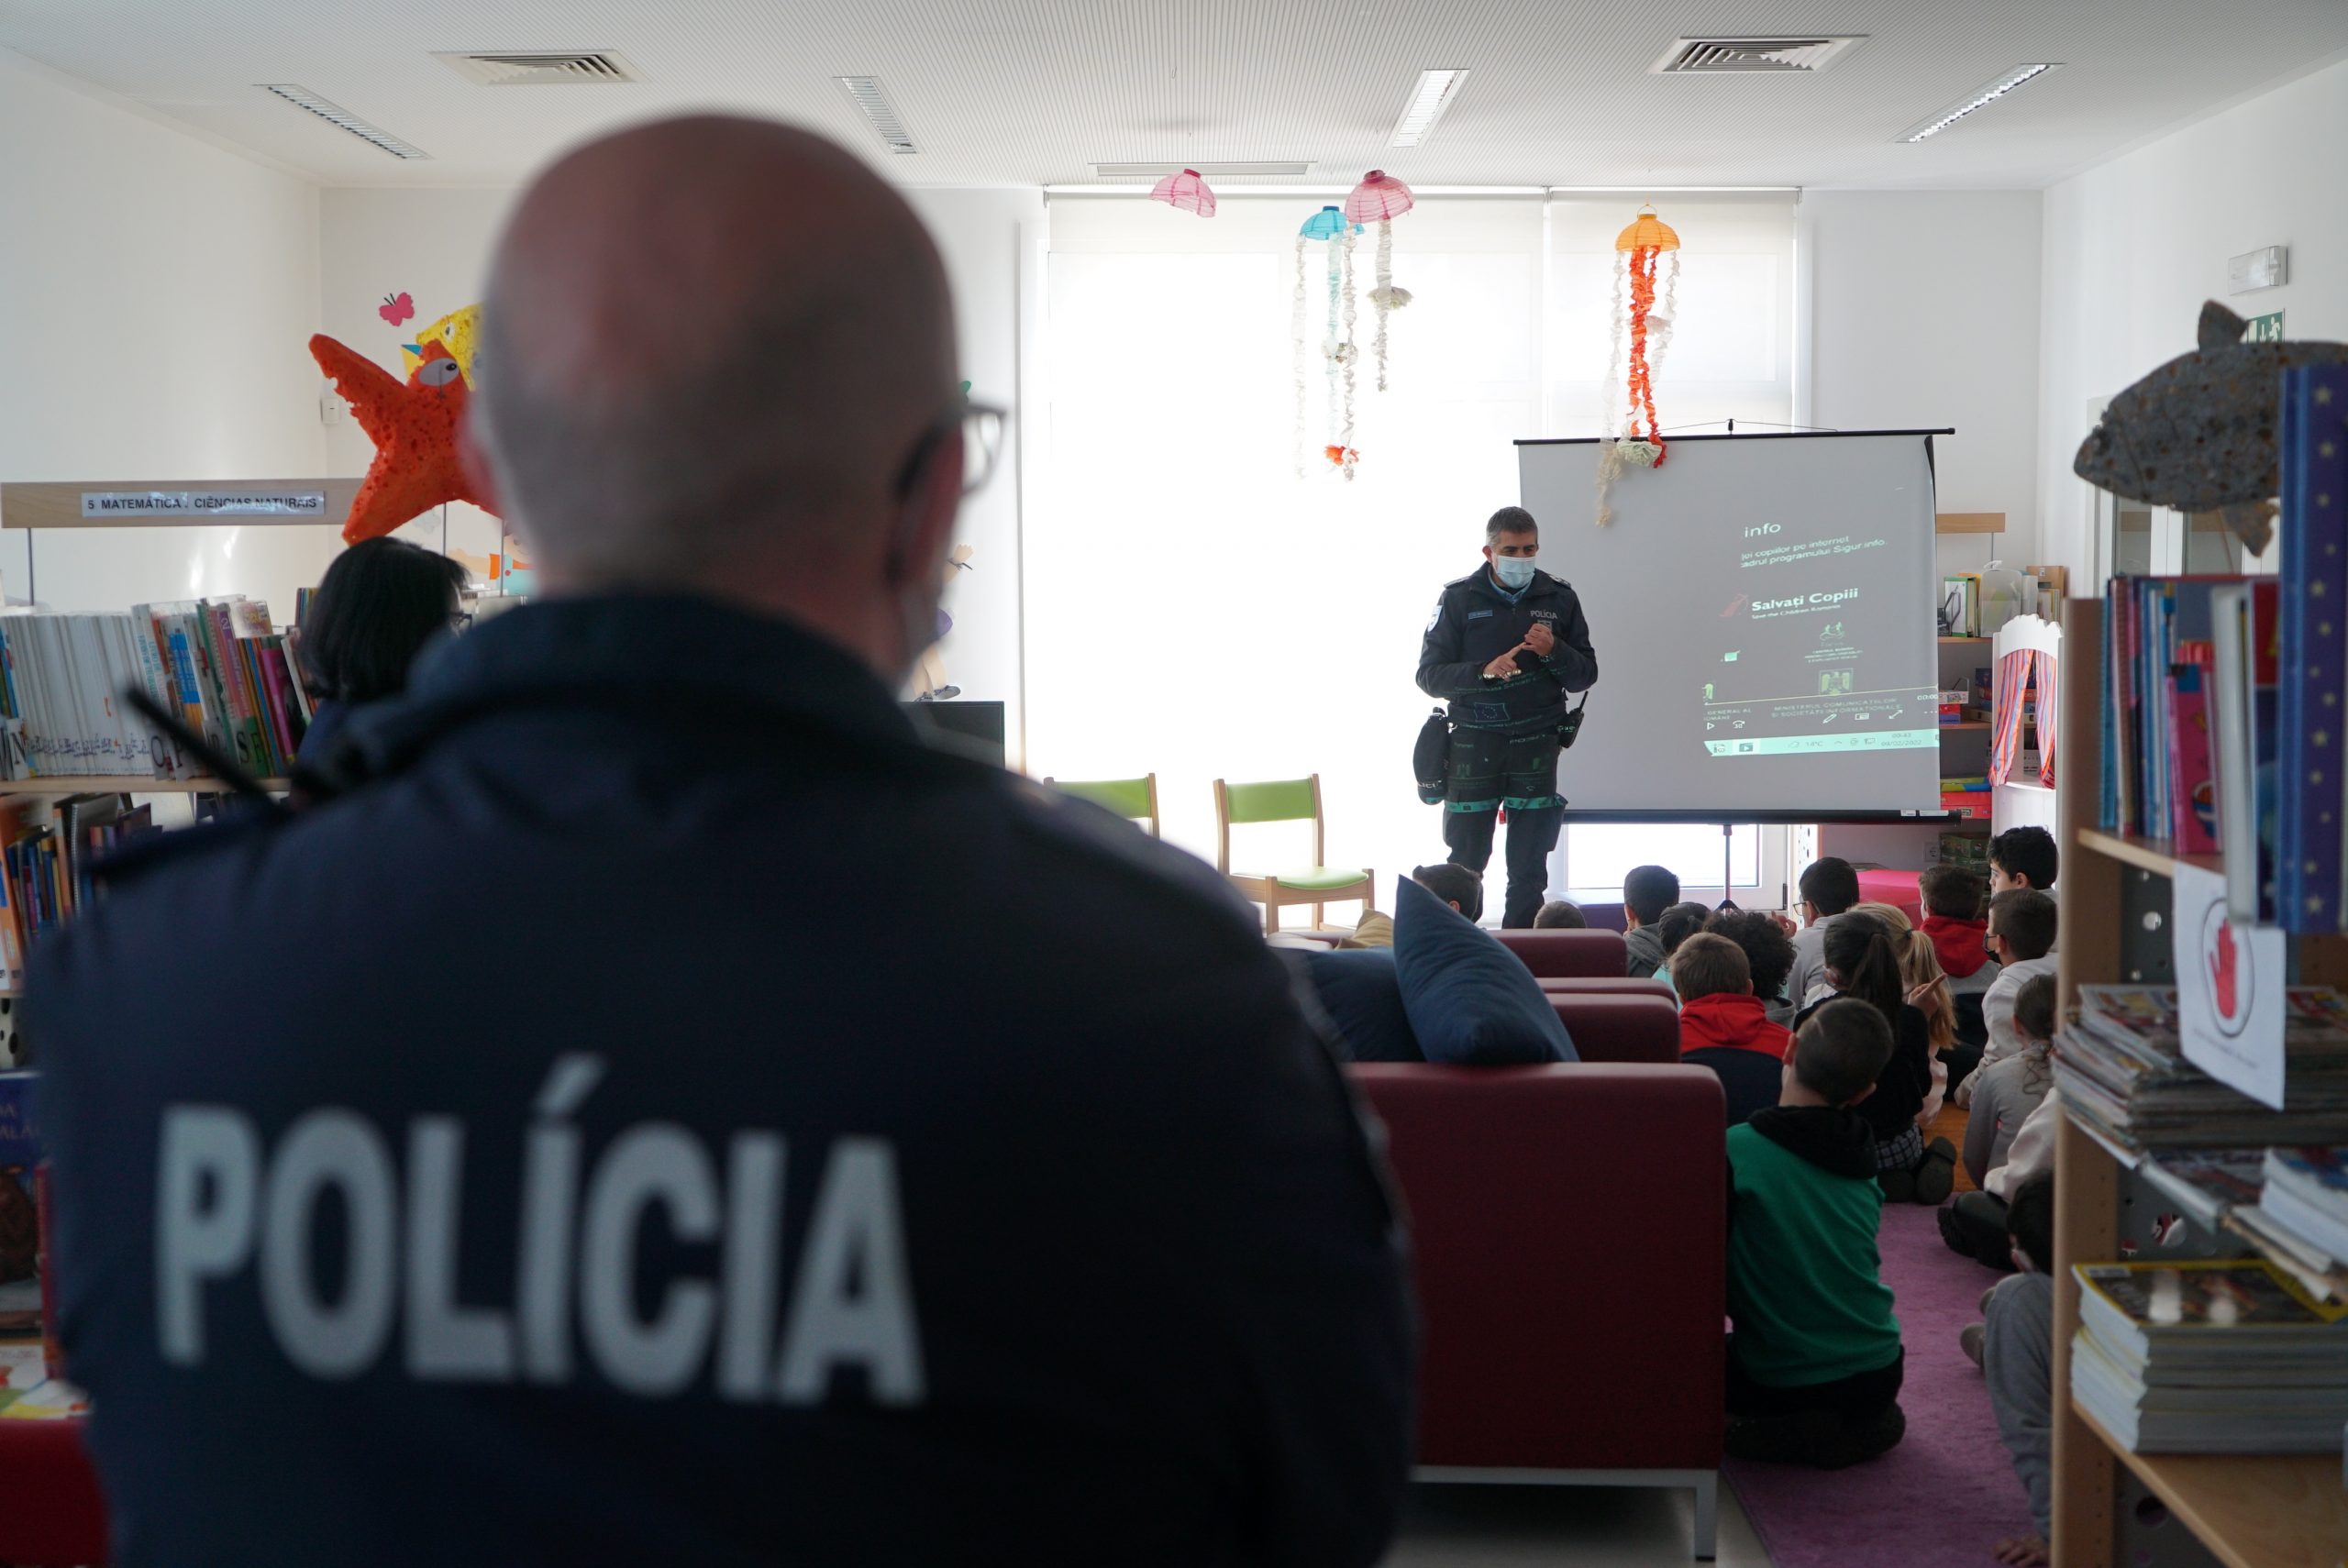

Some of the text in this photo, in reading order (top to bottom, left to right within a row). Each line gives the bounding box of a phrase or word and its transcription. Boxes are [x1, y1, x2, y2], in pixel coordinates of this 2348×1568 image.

[87, 500, 94, 510] 5
[101, 496, 182, 510] MATEMÁTICA
[194, 495, 251, 510] CIÊNCIAS
[255, 496, 316, 509] NATURAIS
[1744, 523, 1781, 537] info
[1809, 536, 1849, 549] internet
[1769, 548, 1832, 565] programului
[1809, 588, 1859, 604] Copiii
[1530, 609, 1557, 620] POLÍCIA
[154, 1051, 928, 1407] POLÍCIA
